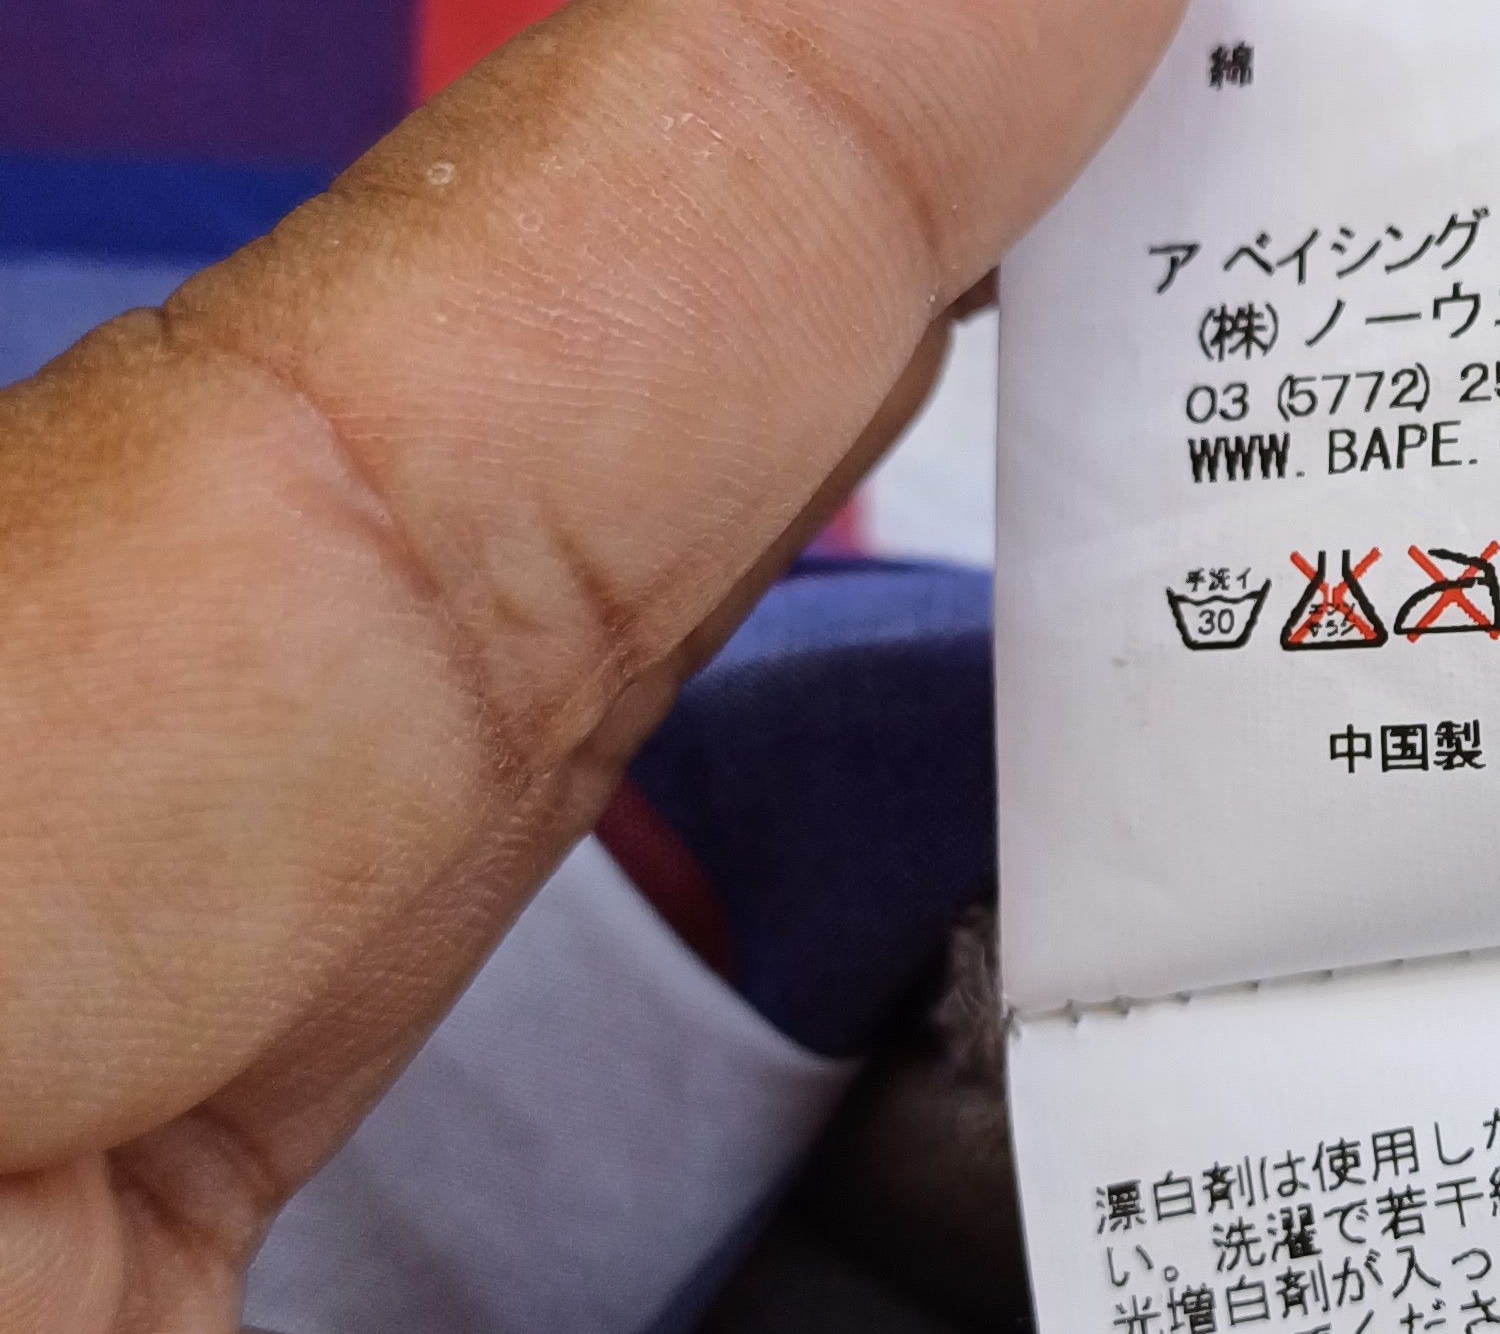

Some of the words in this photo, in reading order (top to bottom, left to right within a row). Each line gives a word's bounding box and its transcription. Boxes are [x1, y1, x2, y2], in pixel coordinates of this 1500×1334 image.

[1208, 41, 1254, 89] 綿
[1186, 381, 1250, 424] 03
[1276, 361, 1431, 423] (5772)
[1198, 608, 1235, 635] 30
[1328, 718, 1488, 774] 中国製
